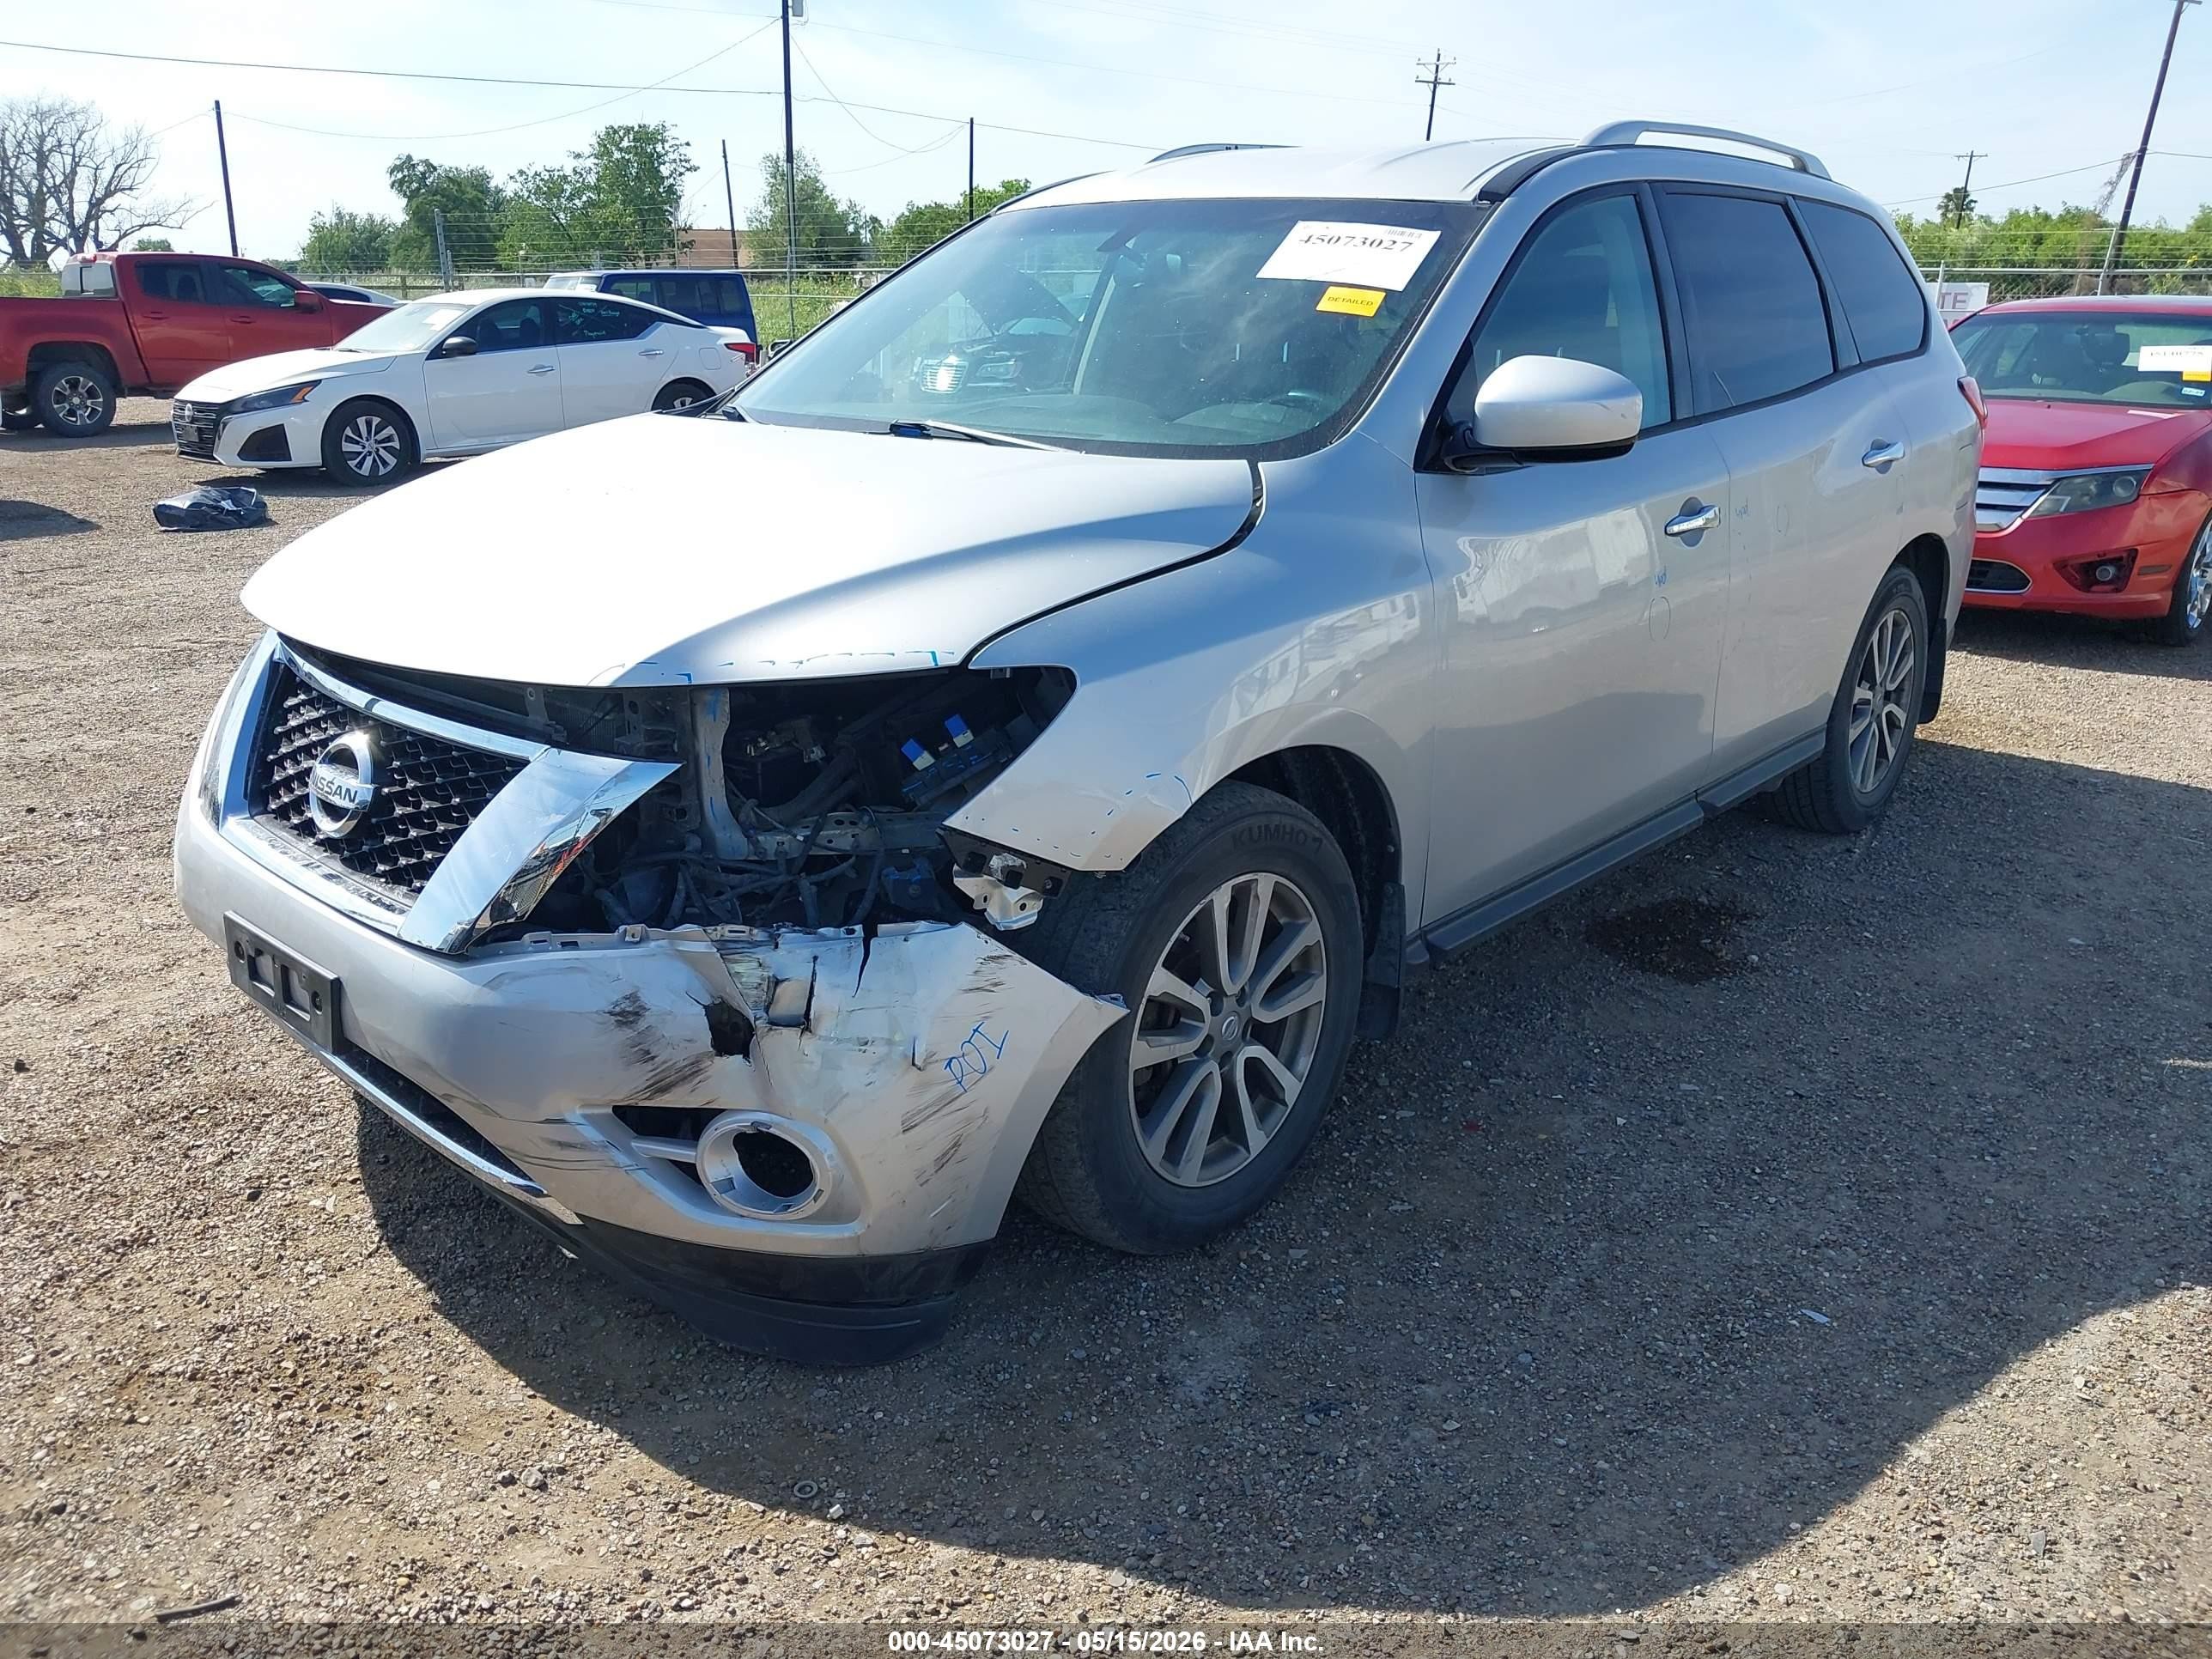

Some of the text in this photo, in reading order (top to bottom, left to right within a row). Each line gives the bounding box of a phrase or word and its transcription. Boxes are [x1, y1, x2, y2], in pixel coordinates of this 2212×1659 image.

[1299, 234, 1413, 252] 45073027
[1327, 295, 1374, 307] DETAILED
[310, 774, 358, 804] NISSAN
[1231, 823, 1308, 852] KUMHO
[944, 1021, 1010, 1093] POI
